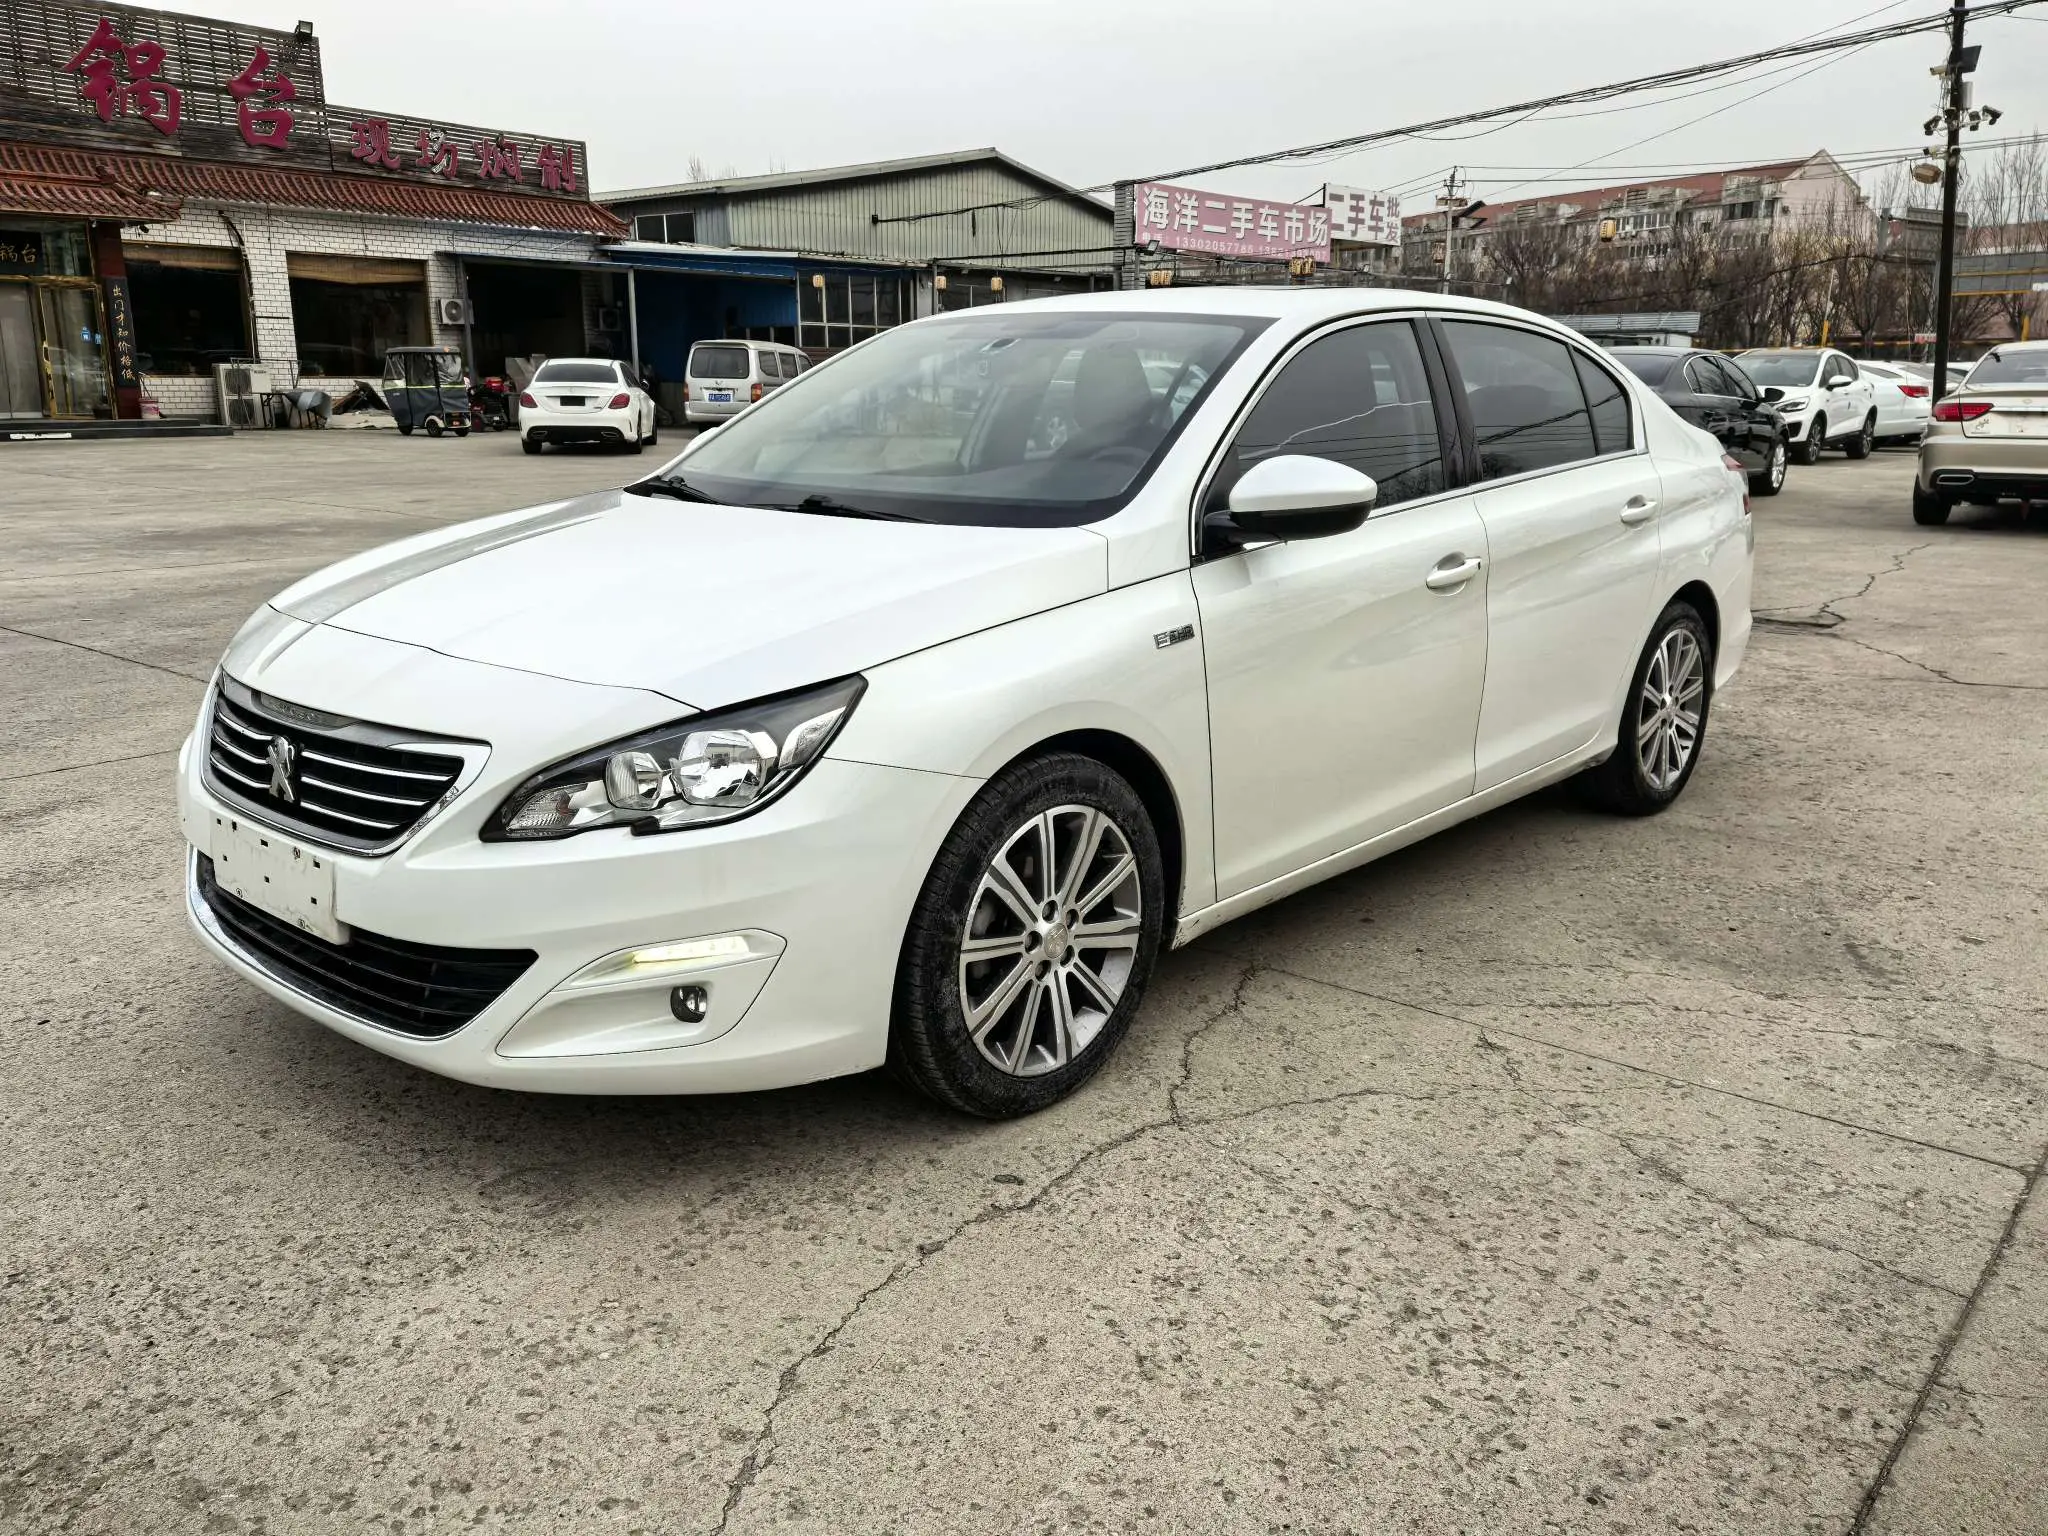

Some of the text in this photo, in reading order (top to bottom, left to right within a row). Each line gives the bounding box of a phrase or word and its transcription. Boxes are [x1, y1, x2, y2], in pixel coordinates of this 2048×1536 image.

[62, 17, 296, 149] 锅台
[1143, 186, 1328, 247] 海洋二手车市场
[1329, 192, 1385, 241] 二手车
